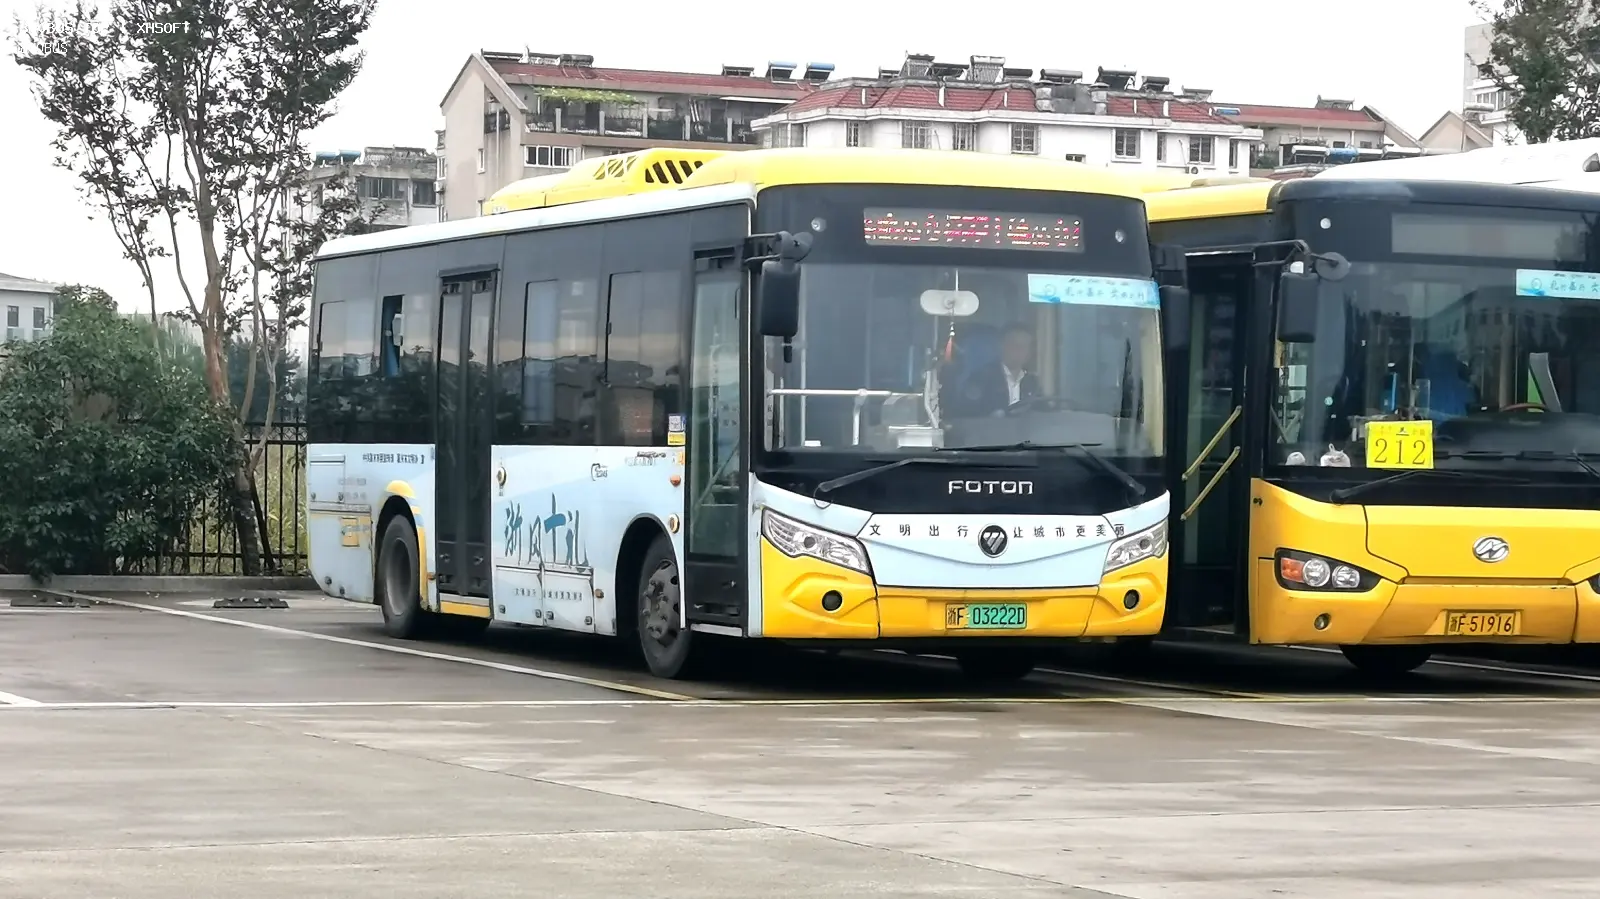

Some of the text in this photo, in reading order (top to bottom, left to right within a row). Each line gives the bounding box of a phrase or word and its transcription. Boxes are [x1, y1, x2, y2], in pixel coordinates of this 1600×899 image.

[1374, 438, 1426, 465] 212
[948, 480, 1034, 495] FOTON
[869, 519, 1125, 539] 文明出行 让城市更美丽
